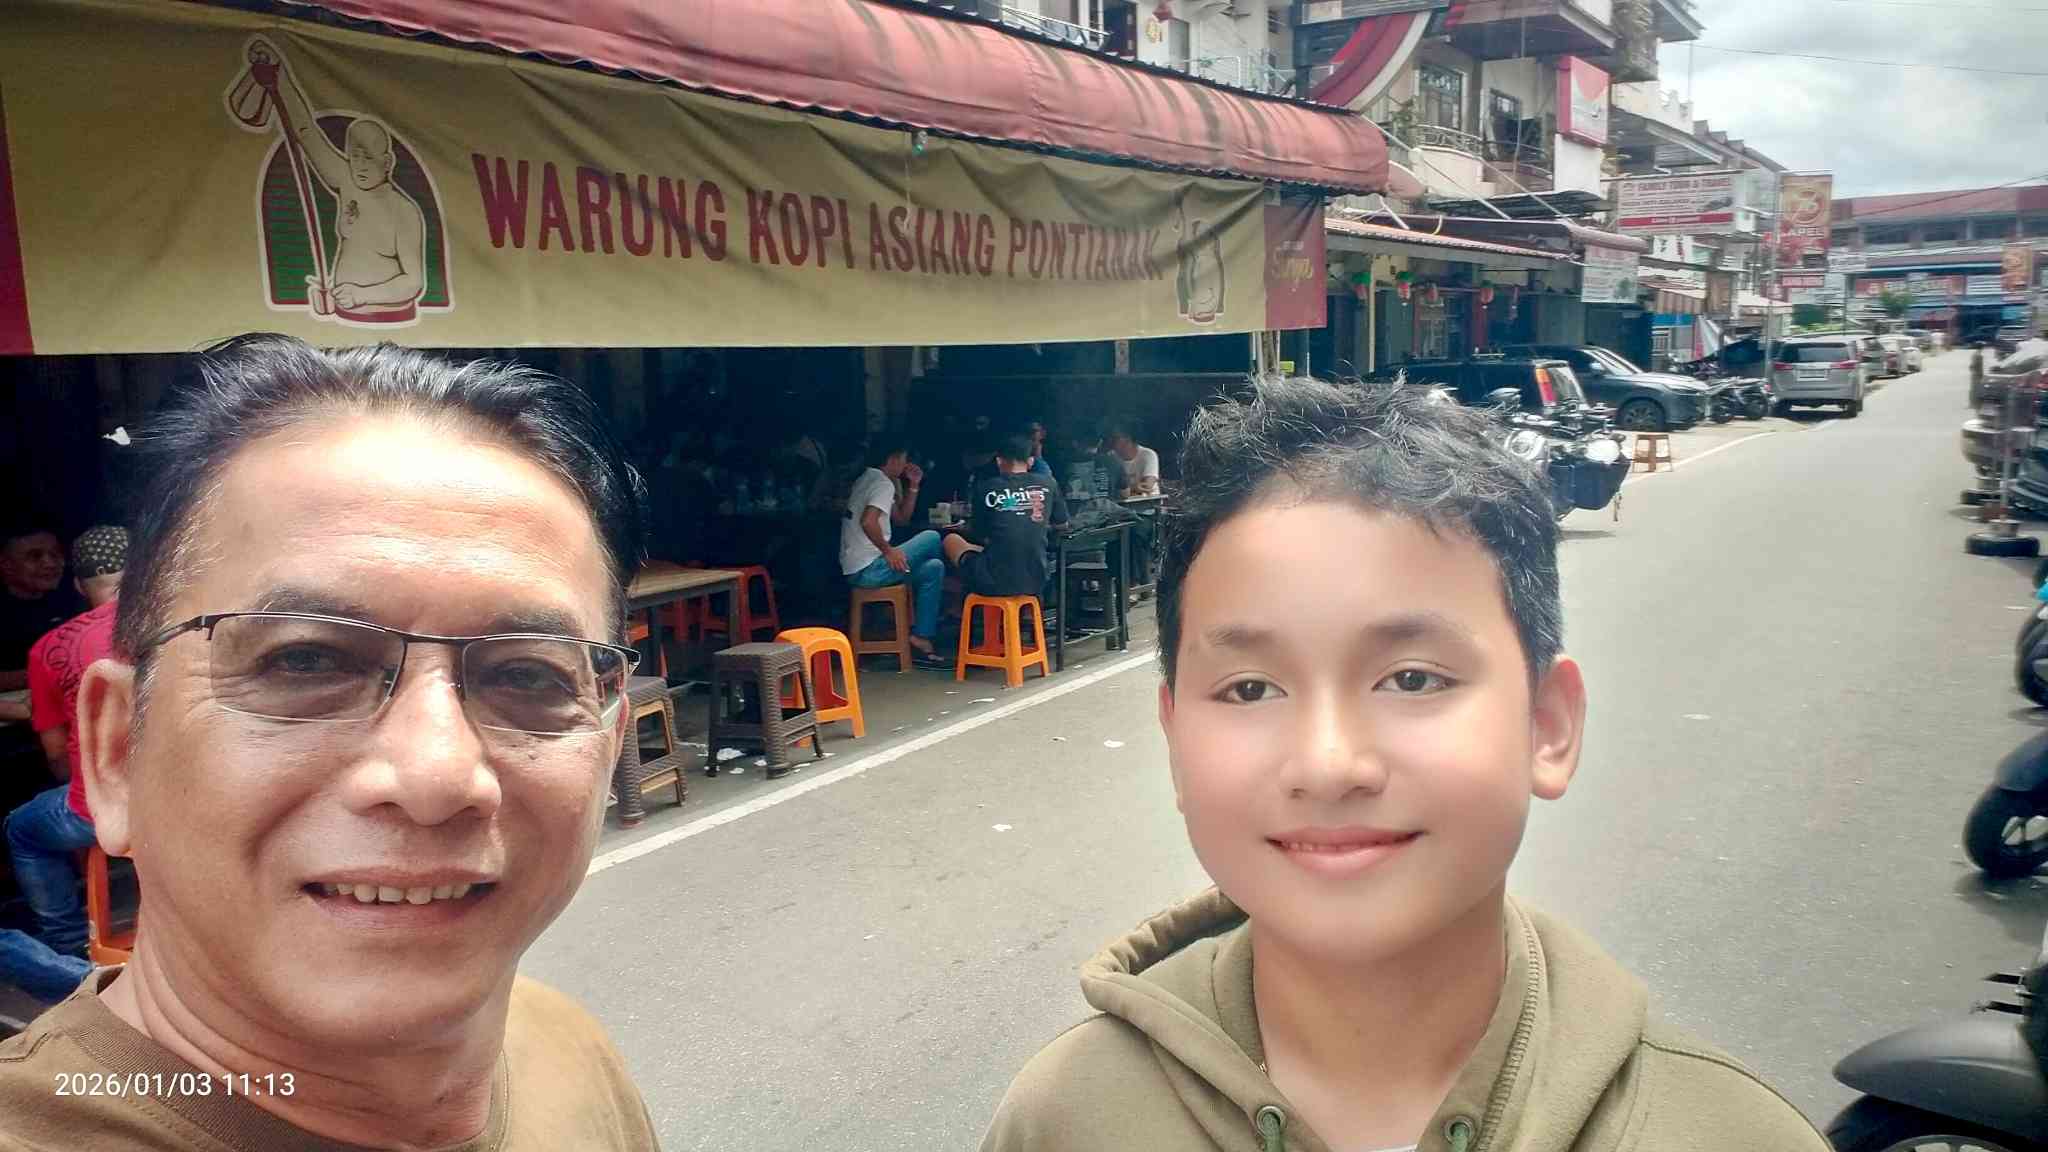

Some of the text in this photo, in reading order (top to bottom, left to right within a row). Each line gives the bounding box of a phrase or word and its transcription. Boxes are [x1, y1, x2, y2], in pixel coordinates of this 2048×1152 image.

[472, 153, 1164, 280] WARUNG KOPI ASIANG PONTIANAK
